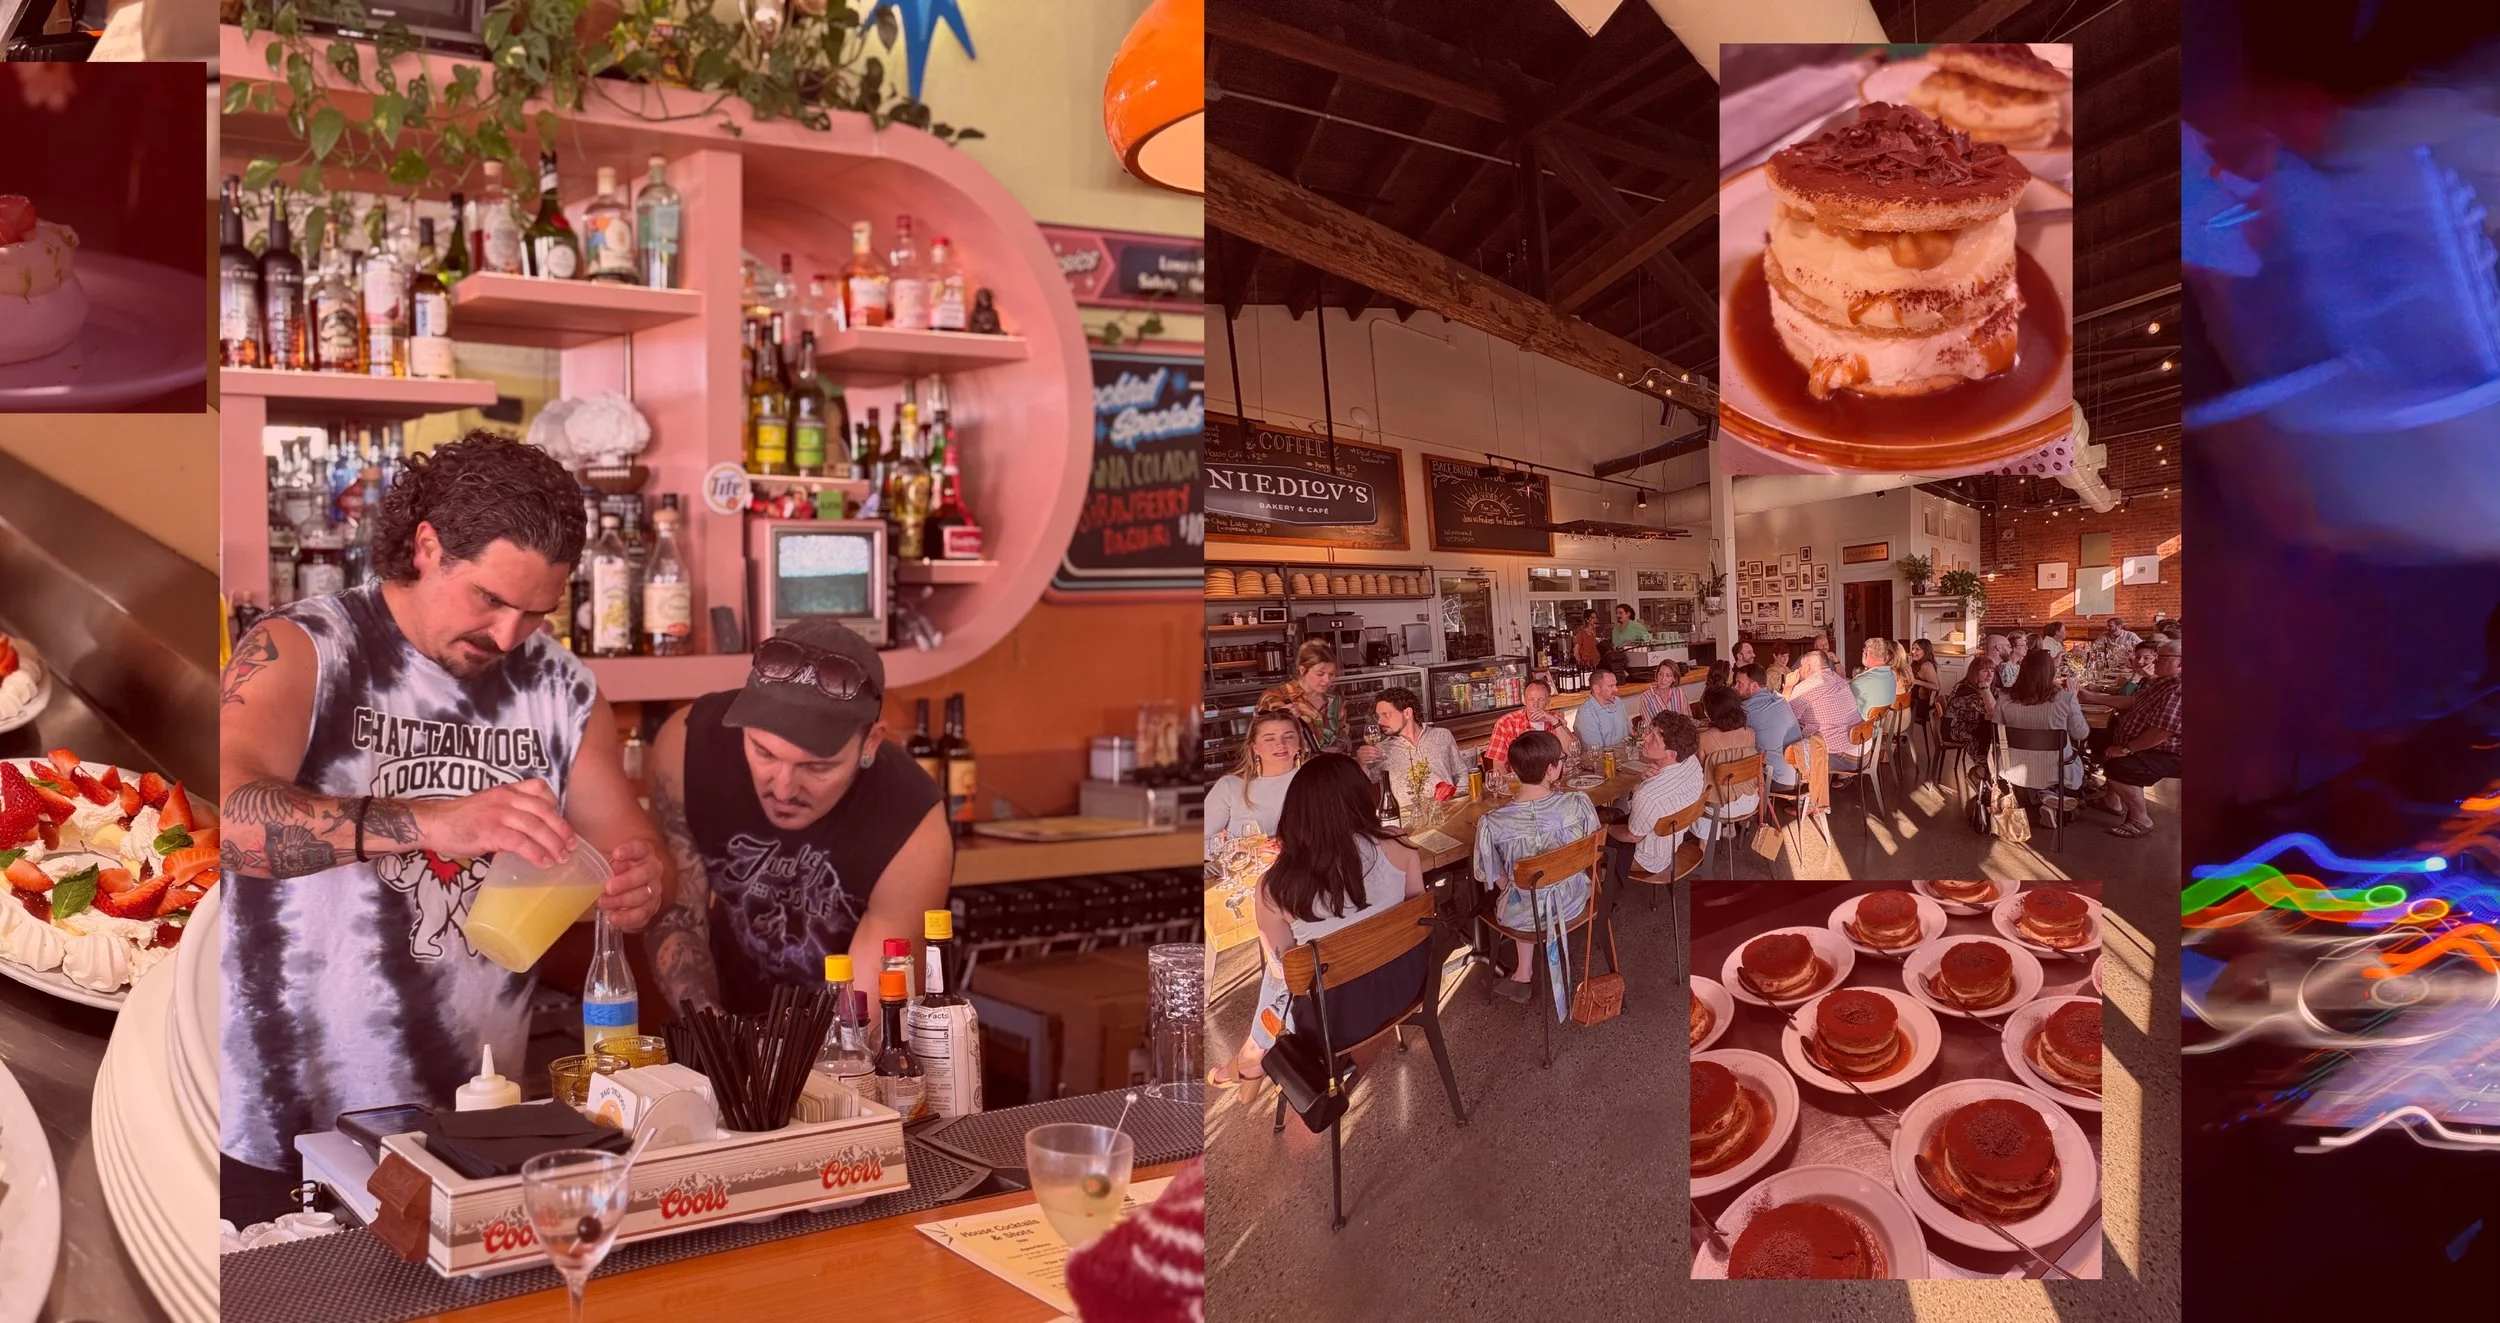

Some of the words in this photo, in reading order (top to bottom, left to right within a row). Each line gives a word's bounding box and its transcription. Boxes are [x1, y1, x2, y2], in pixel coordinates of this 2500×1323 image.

[1259, 431, 1327, 459] COFFEE
[1206, 468, 1369, 504] NIEDLOV'S
[1259, 502, 1295, 512] BAKERY
[1307, 505, 1329, 515] CAFÉ
[351, 706, 549, 770] CHATTANOOGA
[383, 755, 512, 796] LOOKOUT
[943, 1031, 949, 1039] 5
[818, 1157, 885, 1190] Coors
[658, 1186, 730, 1221] Coors
[960, 1226, 994, 1238] House
[994, 1218, 1040, 1231] Cocktails
